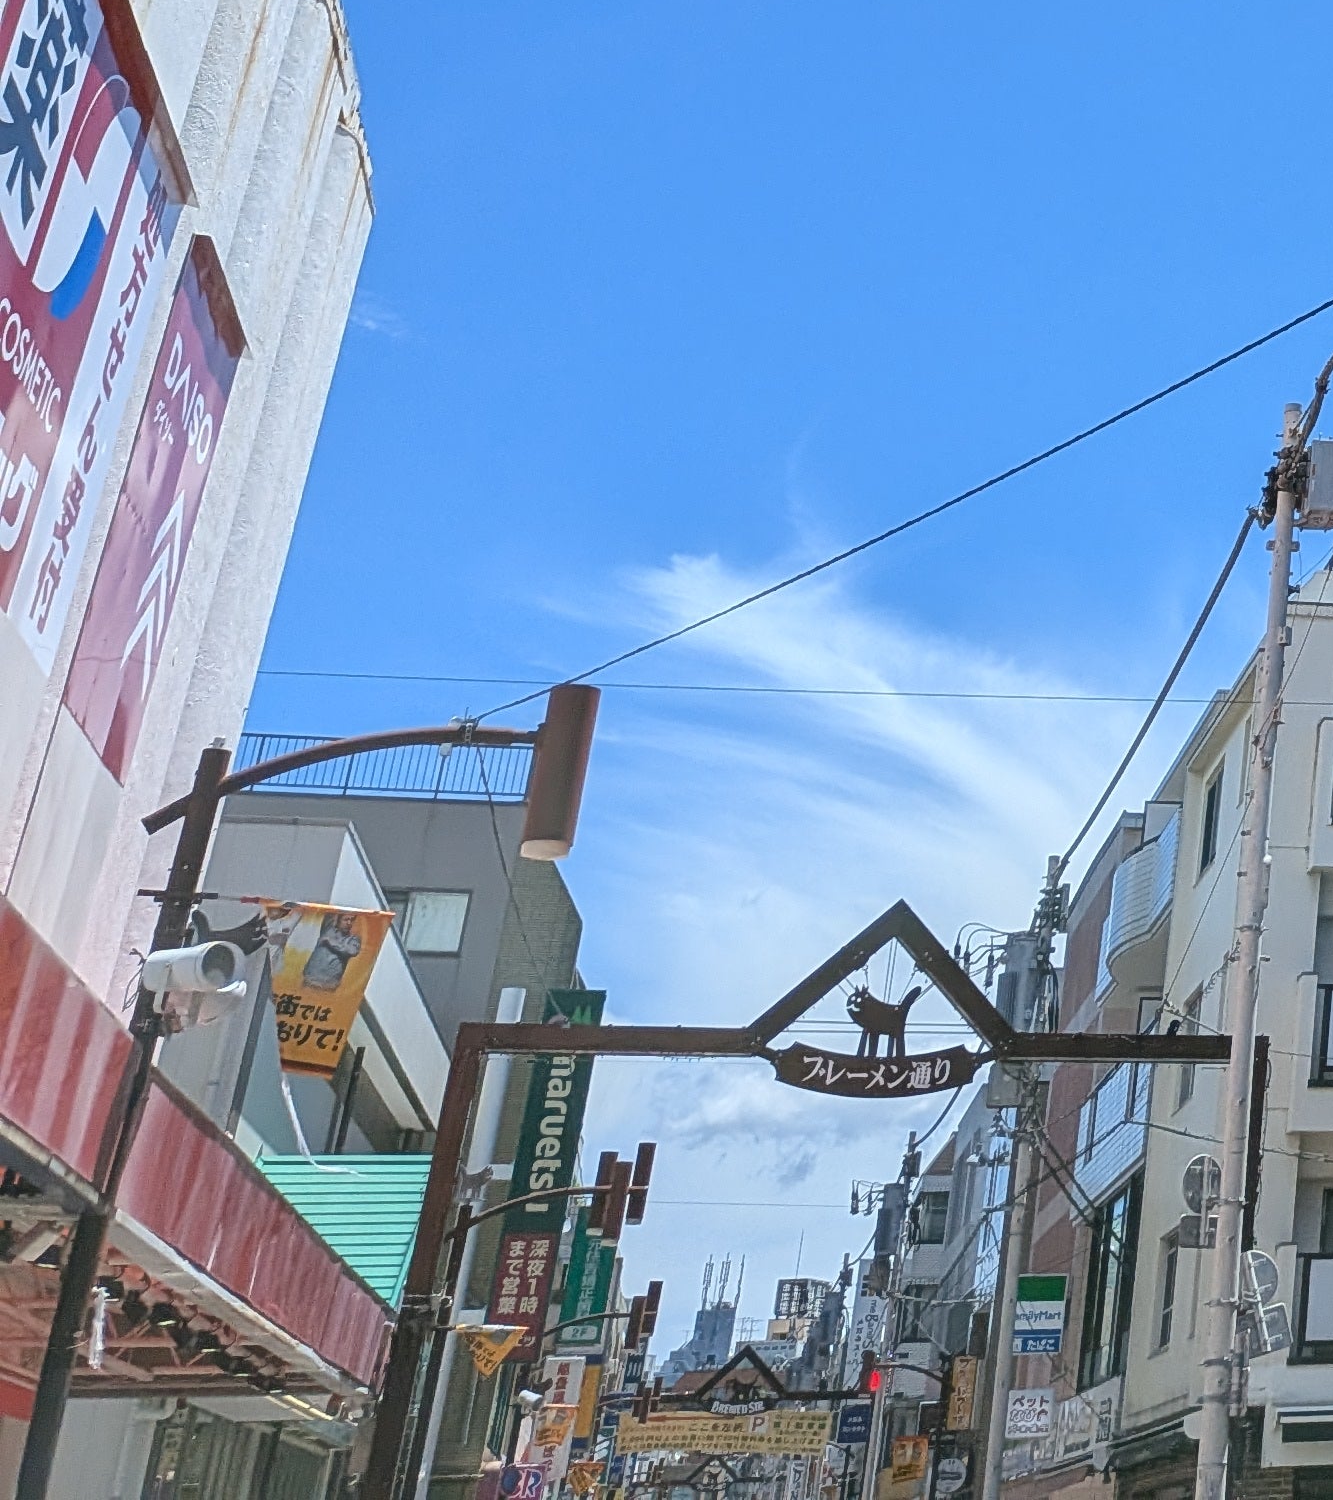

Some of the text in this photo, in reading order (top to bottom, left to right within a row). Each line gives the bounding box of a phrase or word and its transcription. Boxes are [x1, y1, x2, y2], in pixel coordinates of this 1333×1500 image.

[163, 331, 213, 465] DAISO
[803, 1056, 951, 1090] ブレーメン通り
[497, 1239, 529, 1314] まで営業
[519, 1239, 549, 1314] 深夜1時
[1015, 1311, 1061, 1323] amilyMart
[1027, 1338, 1055, 1350] たばこ
[1013, 1396, 1049, 1407] ペット
[752, 1416, 764, 1432] P
